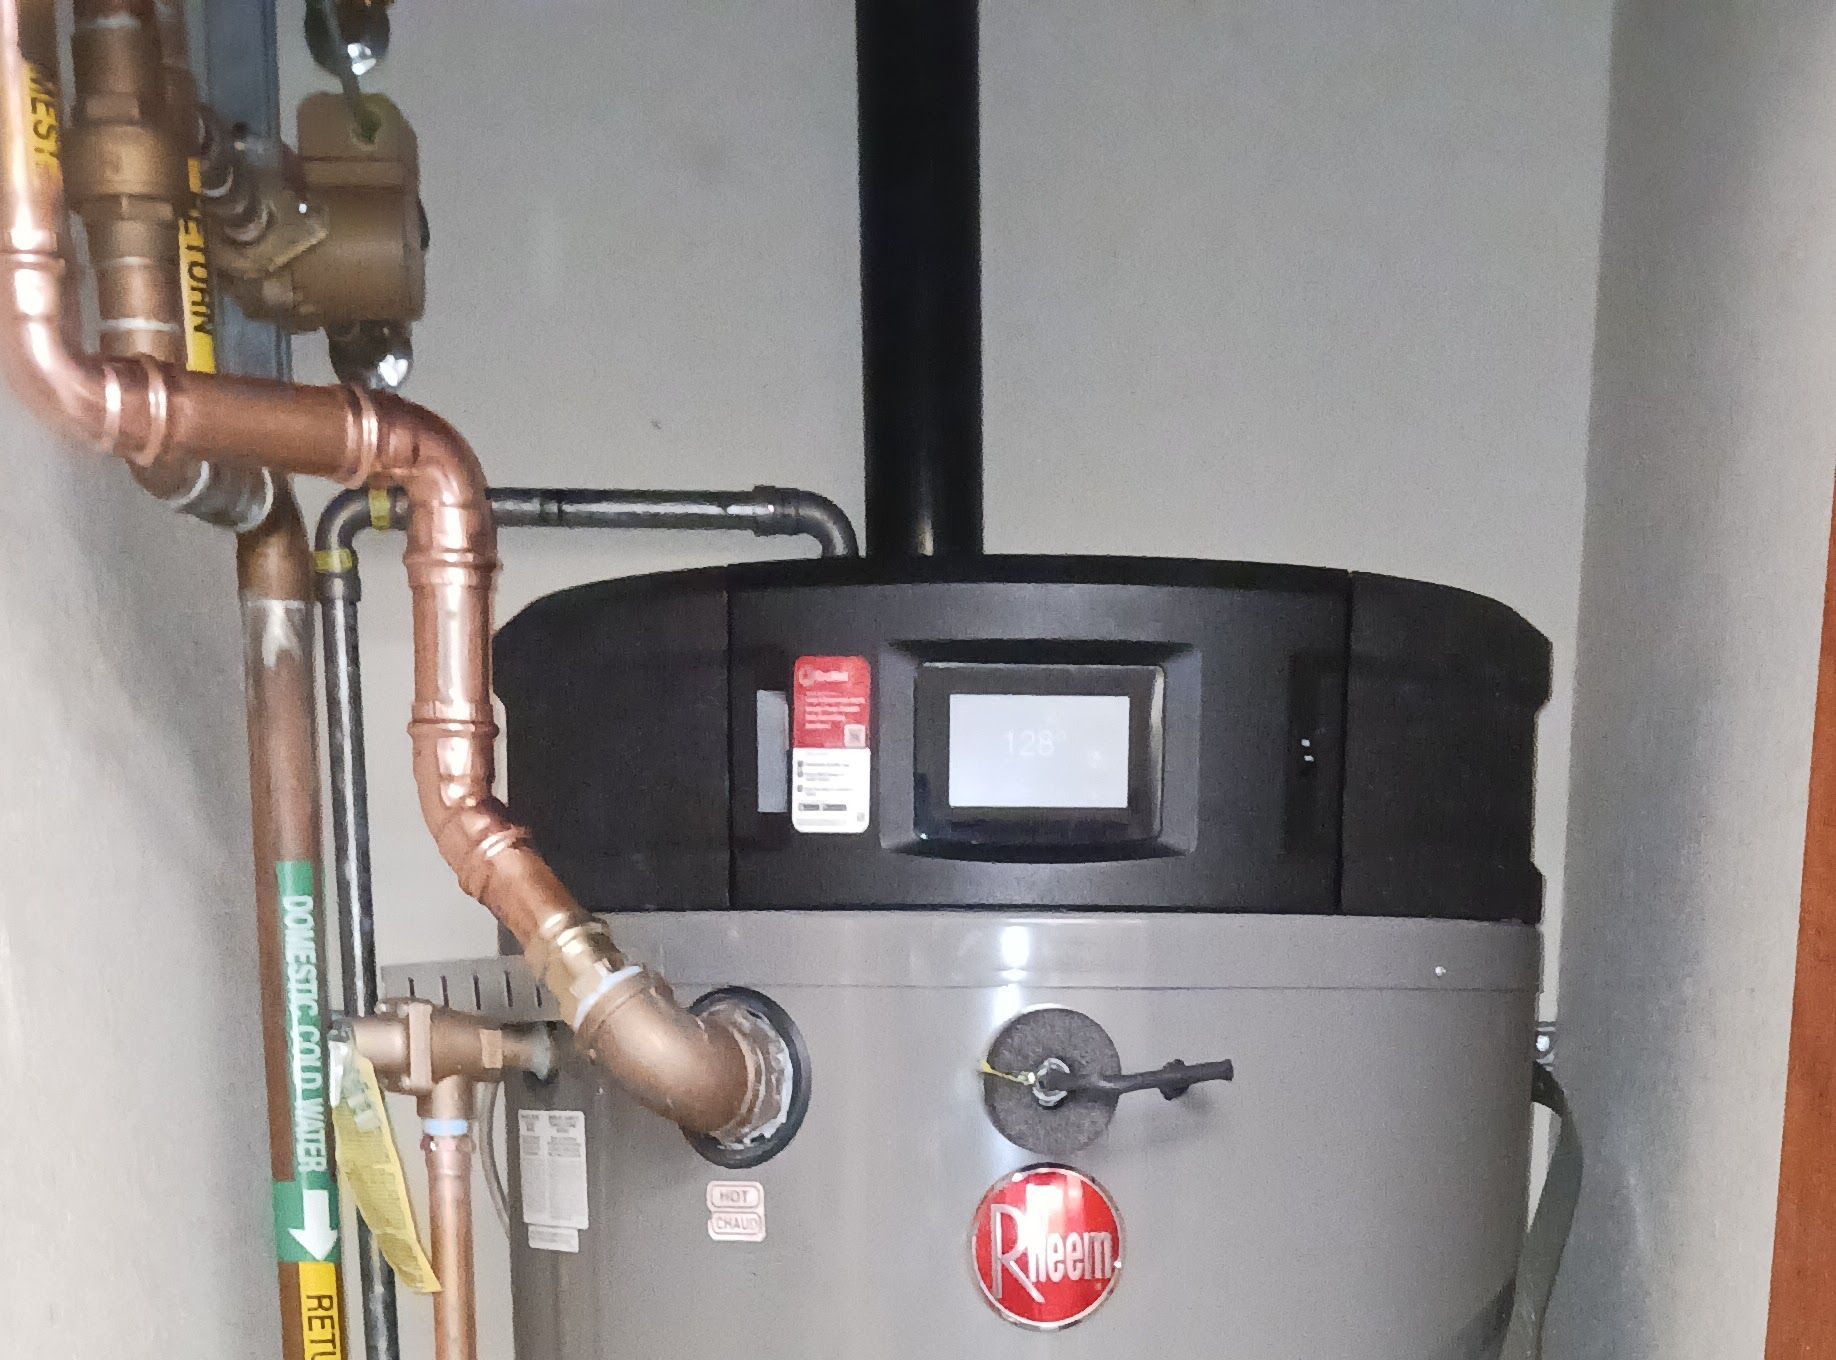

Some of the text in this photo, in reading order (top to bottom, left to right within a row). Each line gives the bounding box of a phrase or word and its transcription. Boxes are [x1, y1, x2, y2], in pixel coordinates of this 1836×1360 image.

[283, 895, 328, 1173] DOMESTIC COLD WATER
[720, 1190, 748, 1203] HOT
[990, 1203, 1113, 1303] Rheem
